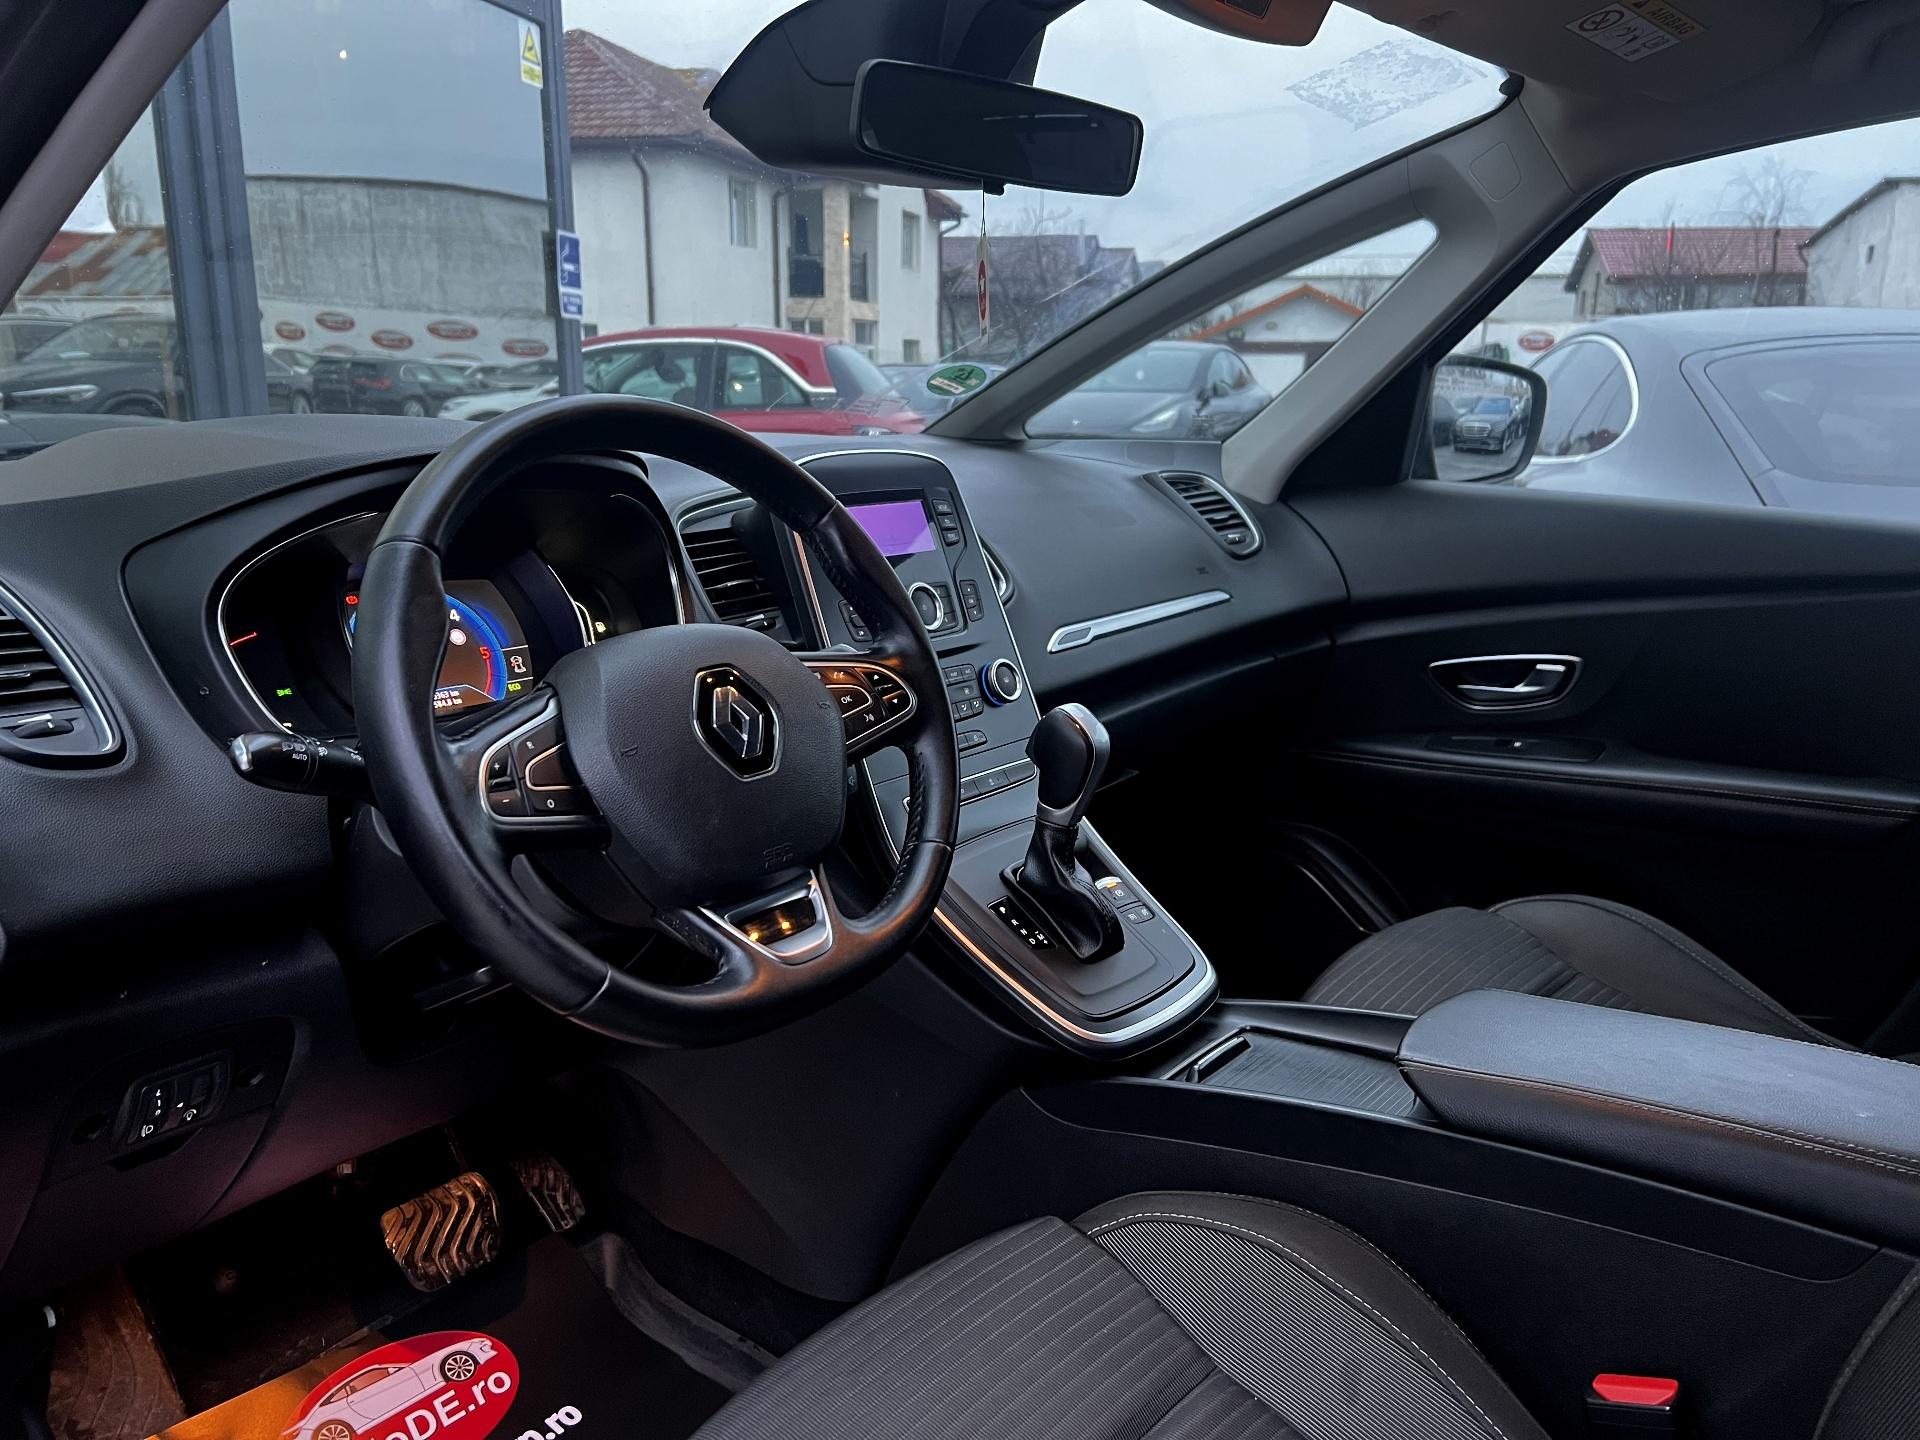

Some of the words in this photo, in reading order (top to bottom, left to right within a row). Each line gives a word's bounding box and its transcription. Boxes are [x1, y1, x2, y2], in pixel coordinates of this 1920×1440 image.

[1648, 8, 1695, 34] AIRBAG
[449, 609, 461, 621] 4
[479, 646, 491, 659] 5
[507, 683, 521, 692] ECO
[840, 695, 853, 704] OK
[292, 753, 308, 761] AUTO
[1020, 928, 1028, 936] N
